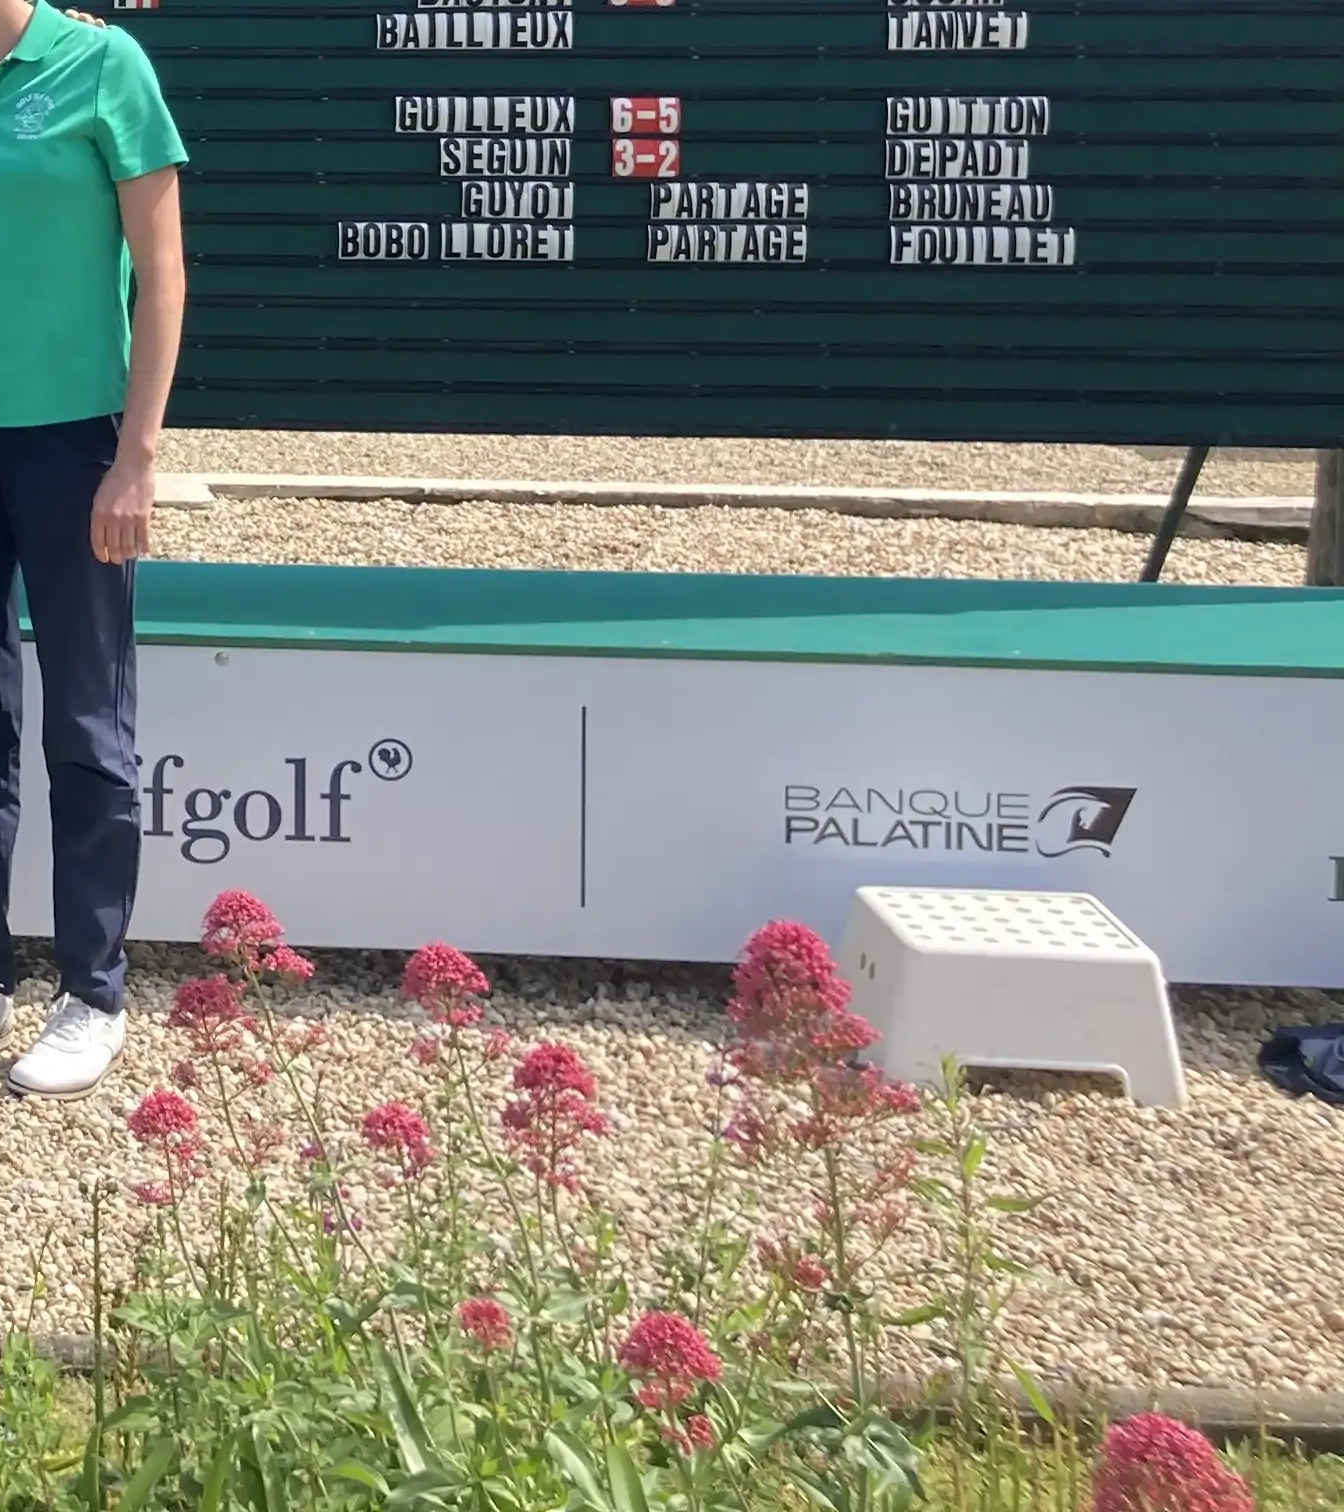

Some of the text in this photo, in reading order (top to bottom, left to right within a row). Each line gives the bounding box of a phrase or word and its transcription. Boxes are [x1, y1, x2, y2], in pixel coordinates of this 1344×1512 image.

[377, 11, 1026, 50] BAILLIEUX TANVET
[396, 97, 1048, 134] GUILLEUX 6-5 GUITTON
[441, 138, 1027, 178] SEGUIN 3-2 DEPADT
[462, 181, 1051, 221] GUYOT PARTAGE BRUNEAU
[339, 222, 1075, 265] BOBO LLORET PARTAGE FOUILLET
[135, 753, 362, 864] fgolf
[784, 784, 1031, 820] BANQUE
[784, 814, 1031, 853] PALATINE
